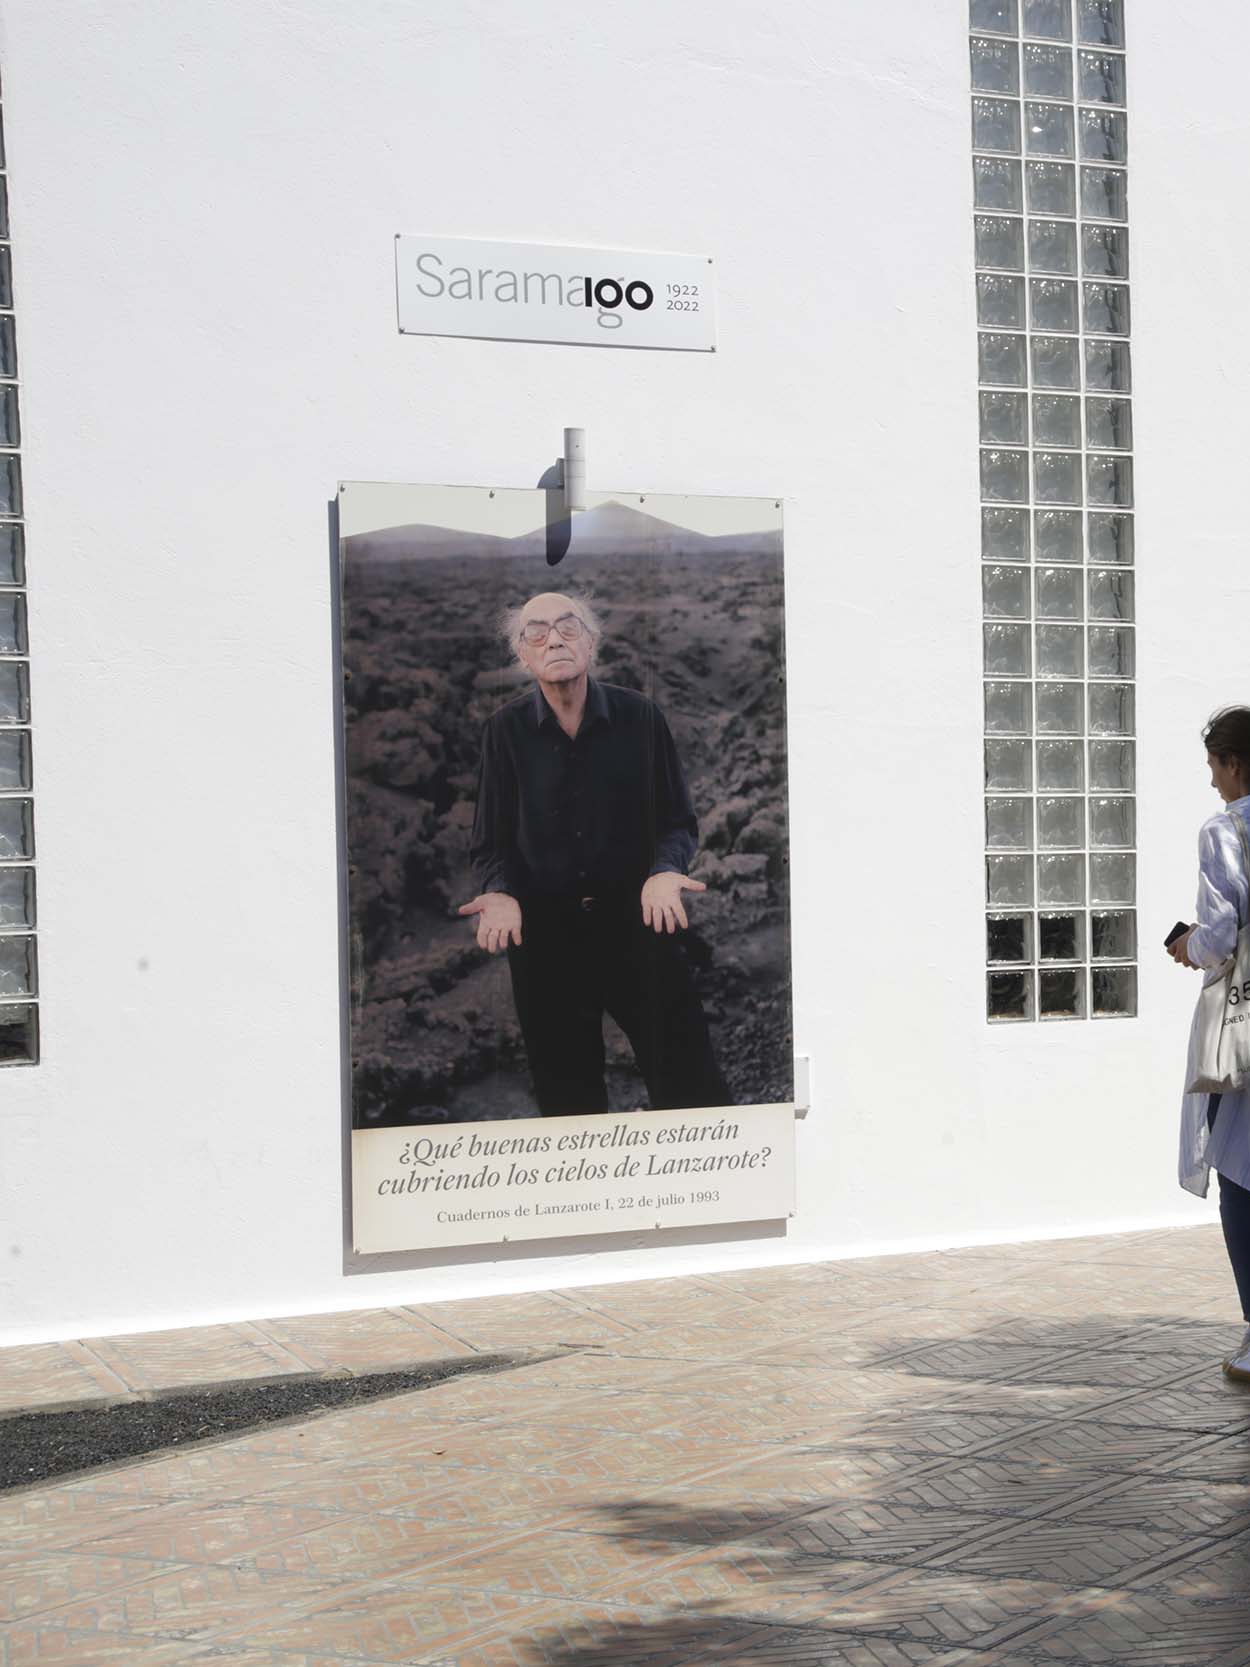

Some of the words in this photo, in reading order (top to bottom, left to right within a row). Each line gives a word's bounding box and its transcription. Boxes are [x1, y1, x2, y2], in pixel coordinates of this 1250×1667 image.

[665, 283, 699, 297] 1922
[666, 299, 700, 312] 2022
[1223, 1014, 1245, 1026] GNED
[399, 1136, 464, 1167] ¿Qué
[468, 1133, 552, 1158] buenas
[557, 1124, 651, 1152] estrellas
[656, 1119, 740, 1145] estarán
[377, 1165, 501, 1196] cubriendo
[506, 1163, 540, 1187] los
[545, 1157, 608, 1183] cielos
[613, 1154, 641, 1178] de
[645, 1146, 772, 1176] Lanzarote?
[436, 1207, 511, 1223] Cuadernos
[514, 1205, 531, 1217] de
[535, 1198, 601, 1216] Lanzarote
[604, 1198, 614, 1211] I,
[618, 1197, 635, 1209] 22
[638, 1195, 654, 1208] de
[655, 1193, 686, 1209] julio
[690, 1190, 721, 1204] 1993
